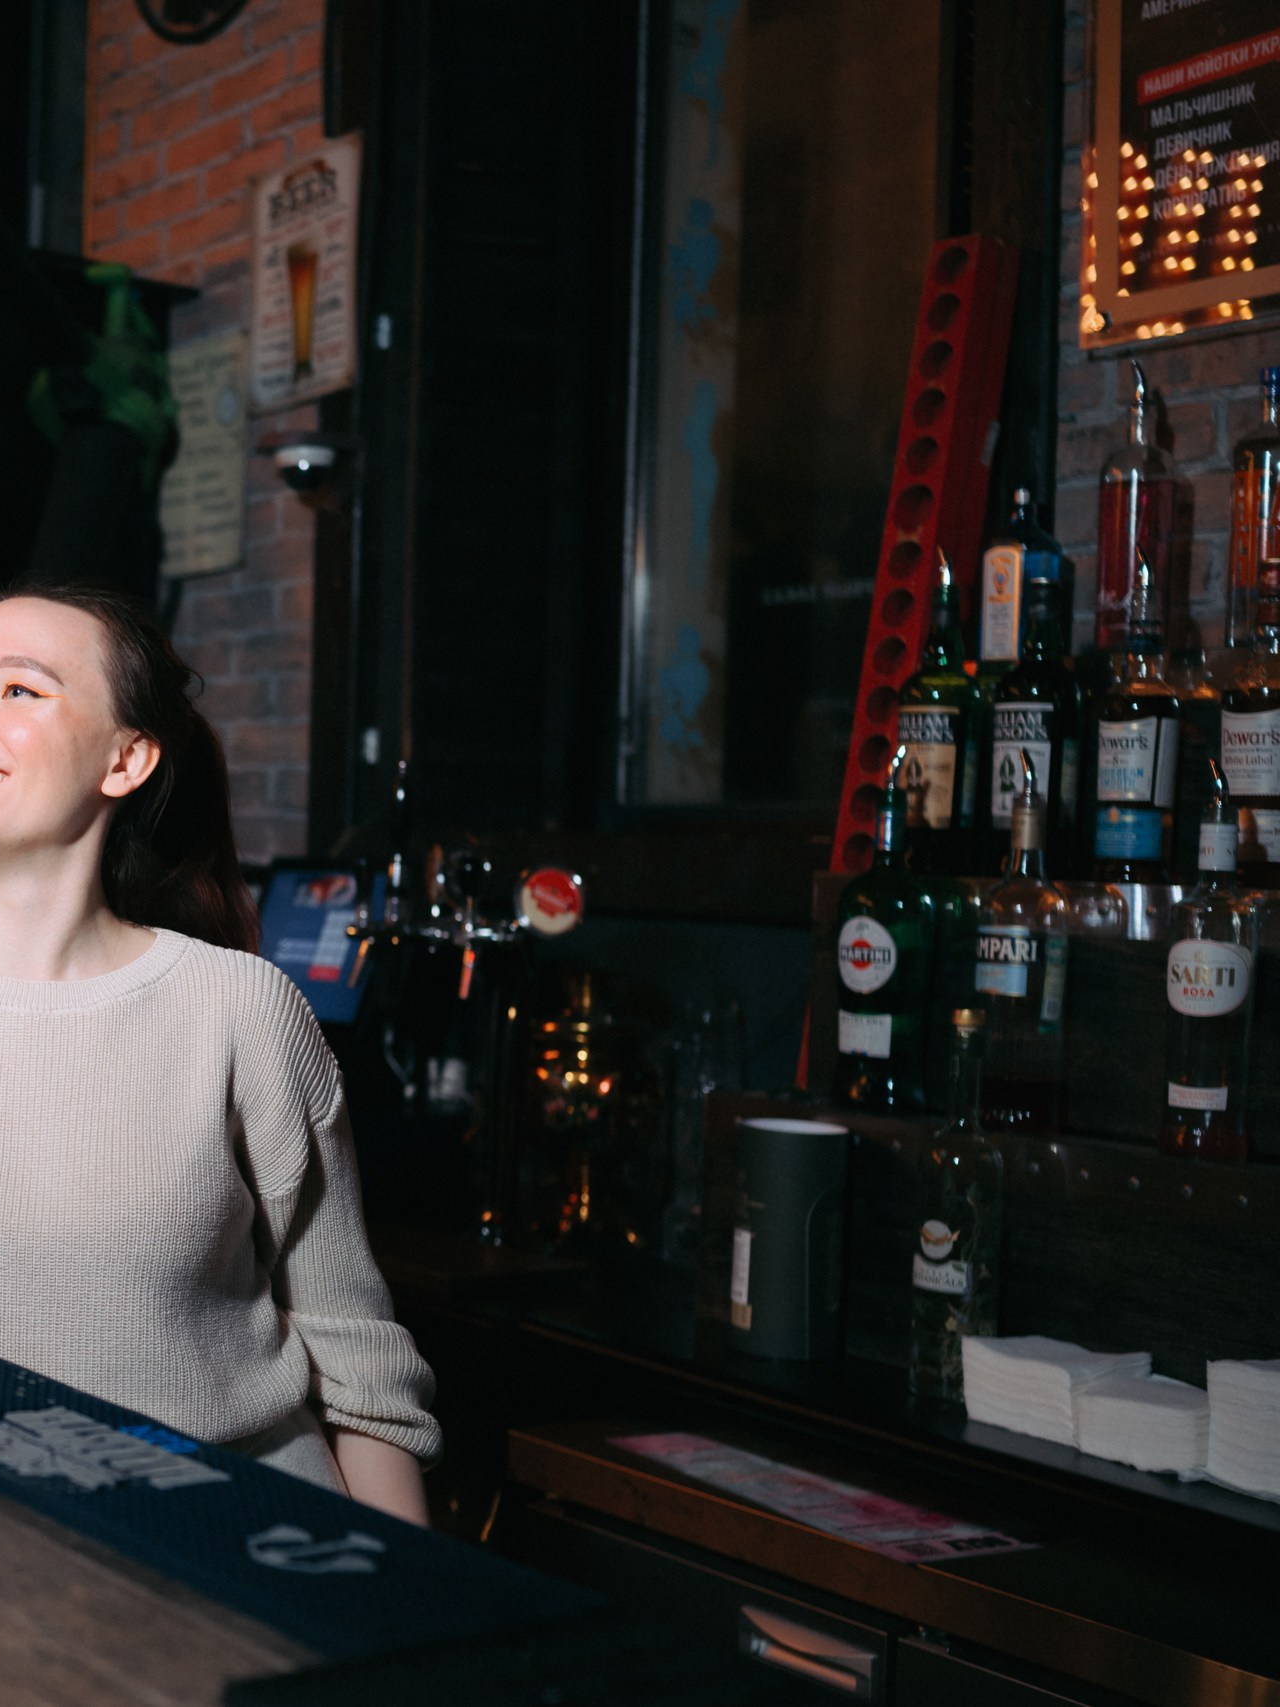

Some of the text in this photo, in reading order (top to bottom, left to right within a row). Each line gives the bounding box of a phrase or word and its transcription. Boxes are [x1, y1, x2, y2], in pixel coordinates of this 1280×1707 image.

[1143, 68, 1184, 96] НАШИ
[1251, 35, 1280, 60] УКР
[1150, 82, 1255, 129] МАЛЬЧИШНИК
[1153, 120, 1232, 160] ДЕВИЧНИК
[840, 946, 892, 964] MARTINI
[1171, 963, 1236, 988] SARTI
[1183, 986, 1215, 998] ROSA
